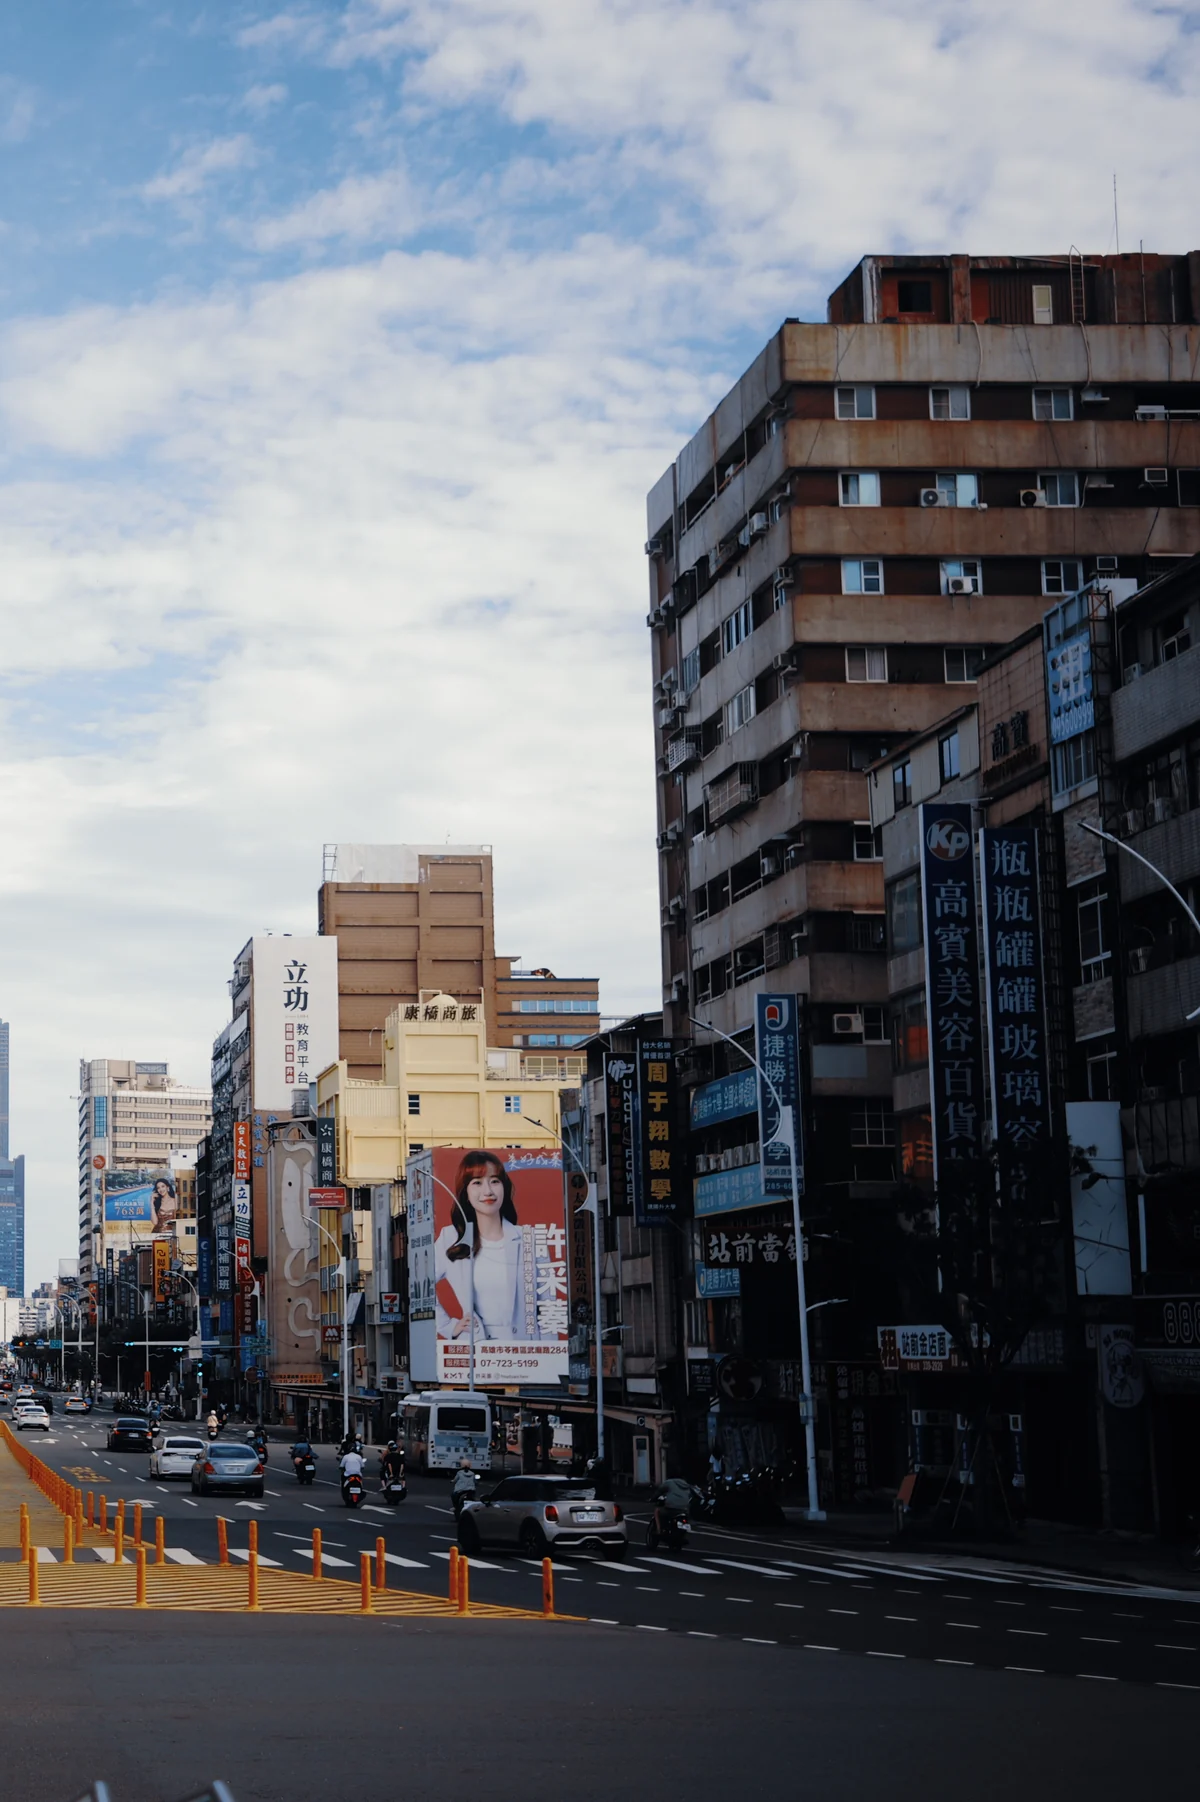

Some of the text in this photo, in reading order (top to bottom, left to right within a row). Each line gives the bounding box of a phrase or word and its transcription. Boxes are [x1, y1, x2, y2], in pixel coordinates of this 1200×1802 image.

[282, 959, 309, 1012] 立功
[404, 1004, 477, 1021] 康橋商旅
[932, 879, 980, 1159] 高賓美容百貨
[296, 1022, 309, 1084] 教育平台
[321, 1142, 333, 1187] 康橋商
[237, 1186, 249, 1215] 立功
[480, 1359, 539, 1368] 07-723-5199
